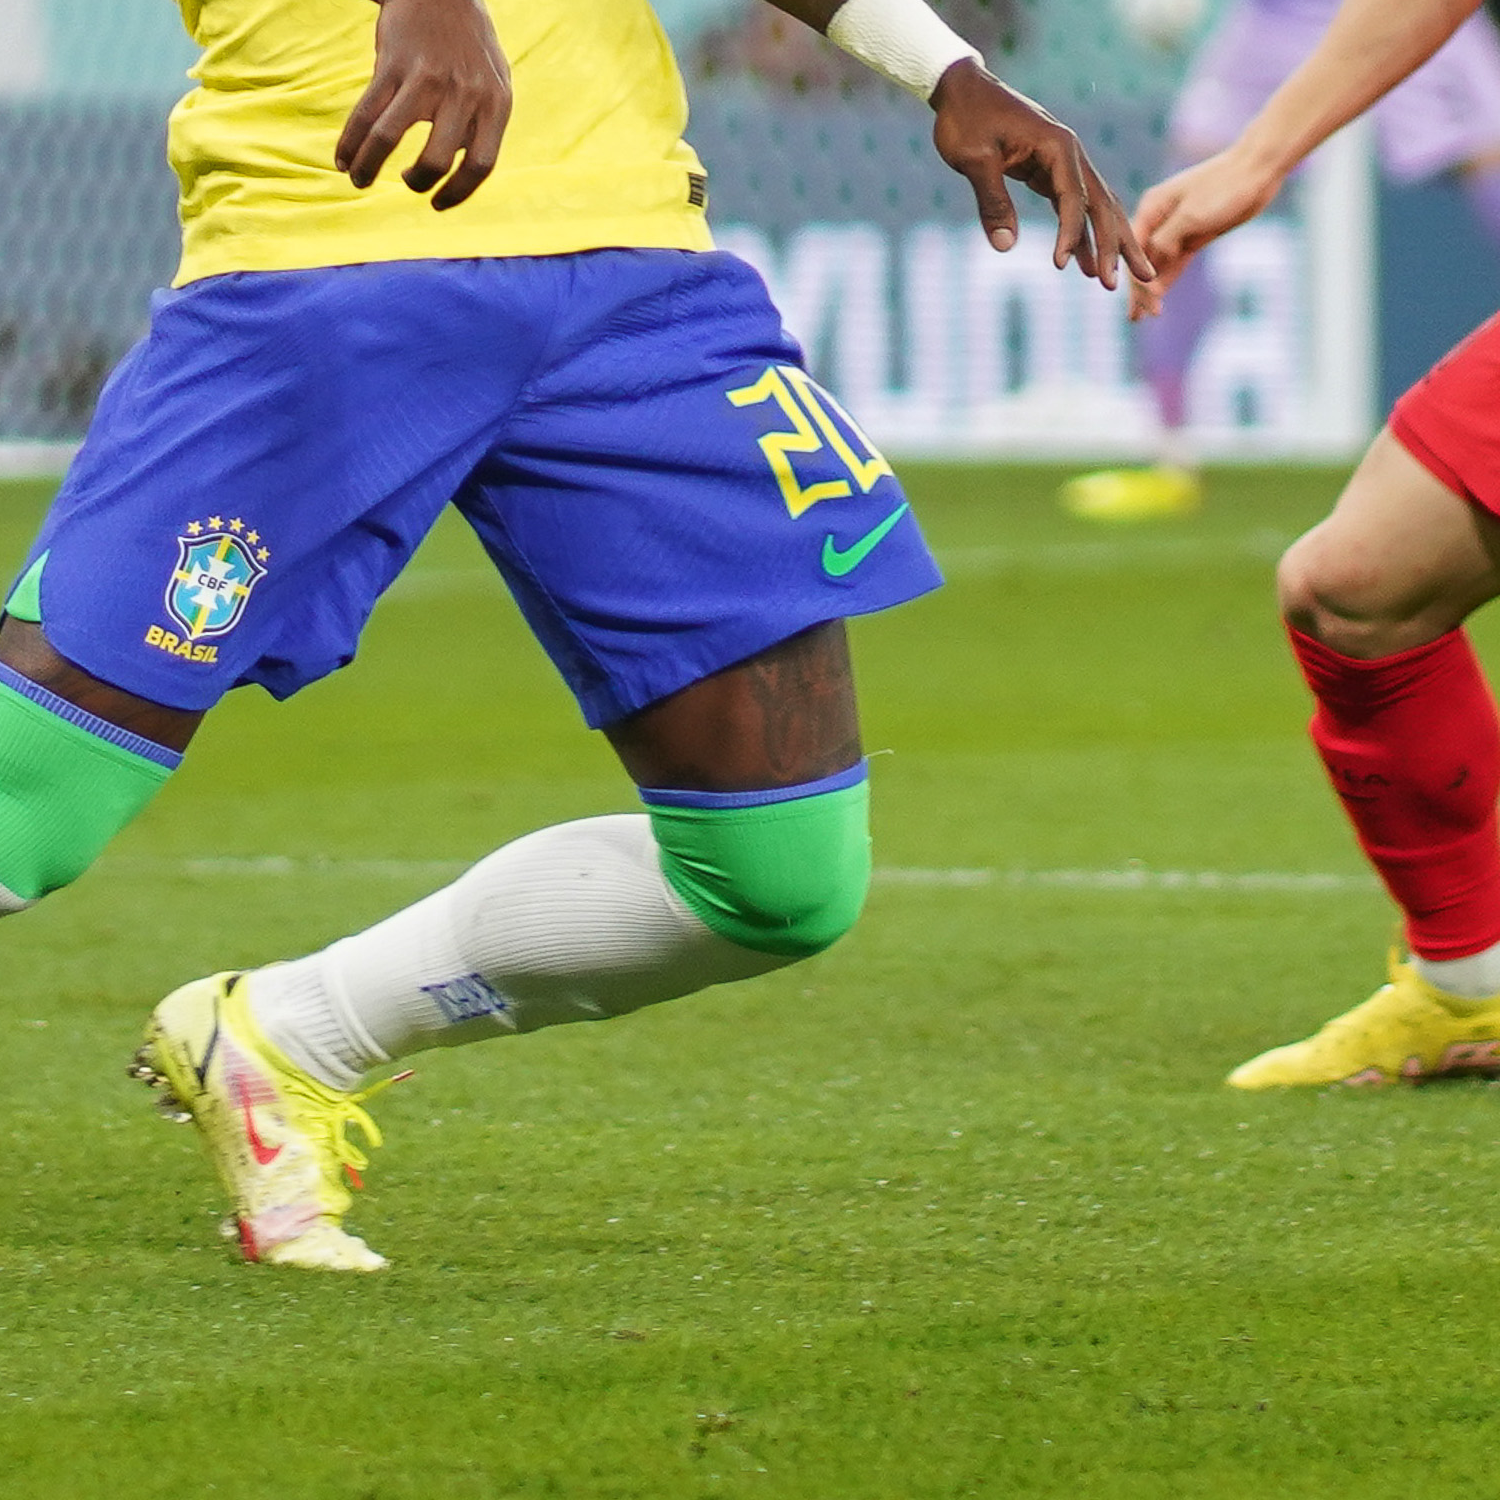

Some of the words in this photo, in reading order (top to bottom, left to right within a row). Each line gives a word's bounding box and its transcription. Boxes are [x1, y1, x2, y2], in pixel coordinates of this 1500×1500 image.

[725, 365, 896, 521] 20
[197, 573, 228, 592] CBF
[145, 624, 219, 664] BRASIL
